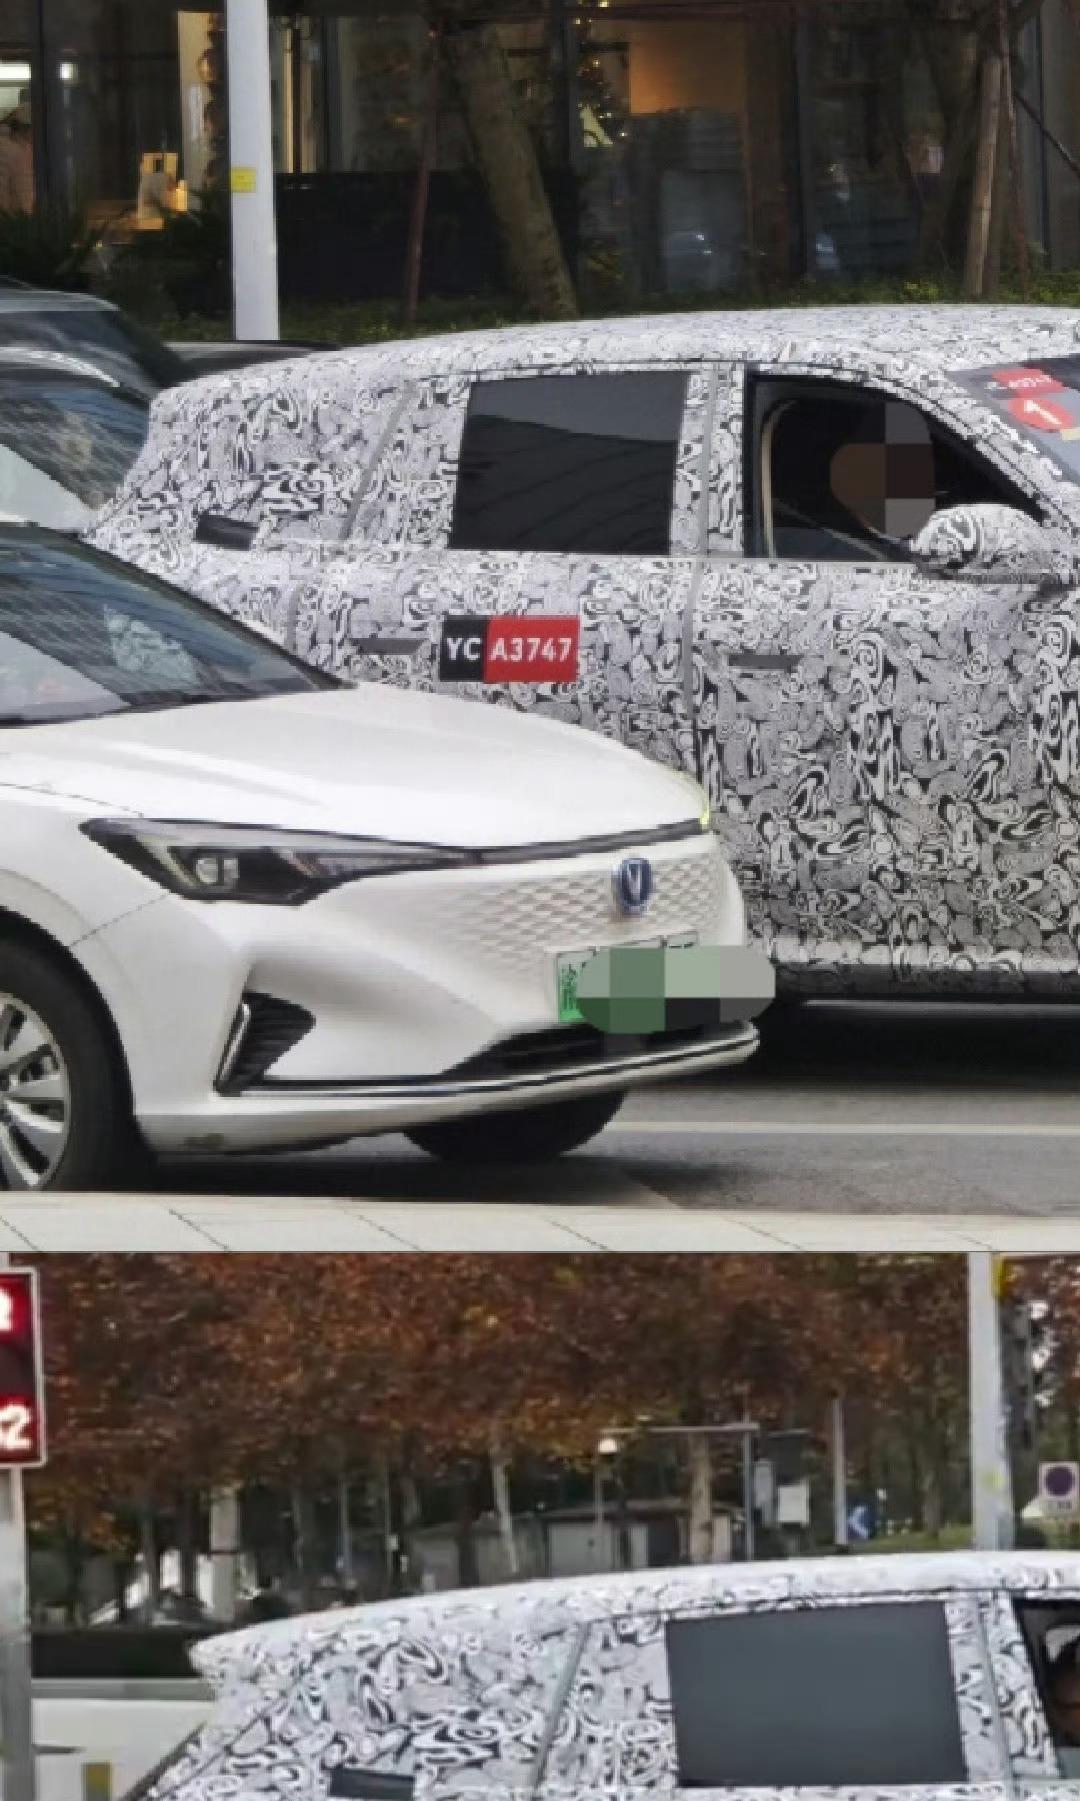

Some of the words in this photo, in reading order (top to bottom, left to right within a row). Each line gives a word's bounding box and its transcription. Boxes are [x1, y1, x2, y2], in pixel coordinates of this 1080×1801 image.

[445, 636, 482, 662] YC
[489, 636, 573, 662] A3747
[0, 1403, 32, 1450] 2
